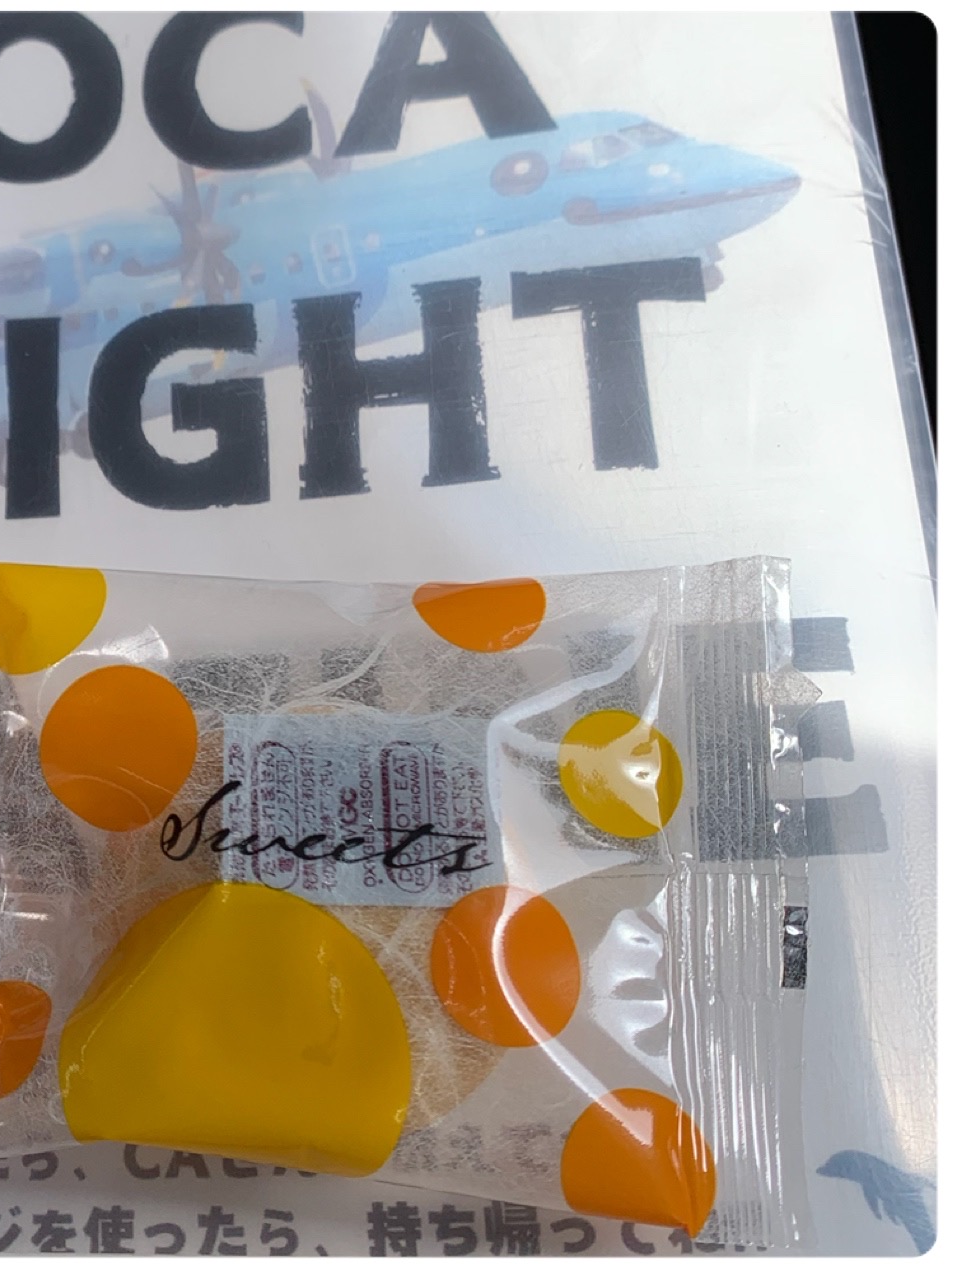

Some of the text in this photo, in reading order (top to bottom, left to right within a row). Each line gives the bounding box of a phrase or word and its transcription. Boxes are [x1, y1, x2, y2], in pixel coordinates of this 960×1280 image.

[260, 753, 276, 878] たられません
[392, 754, 408, 791] EAT
[160, 780, 495, 876] Sweets
